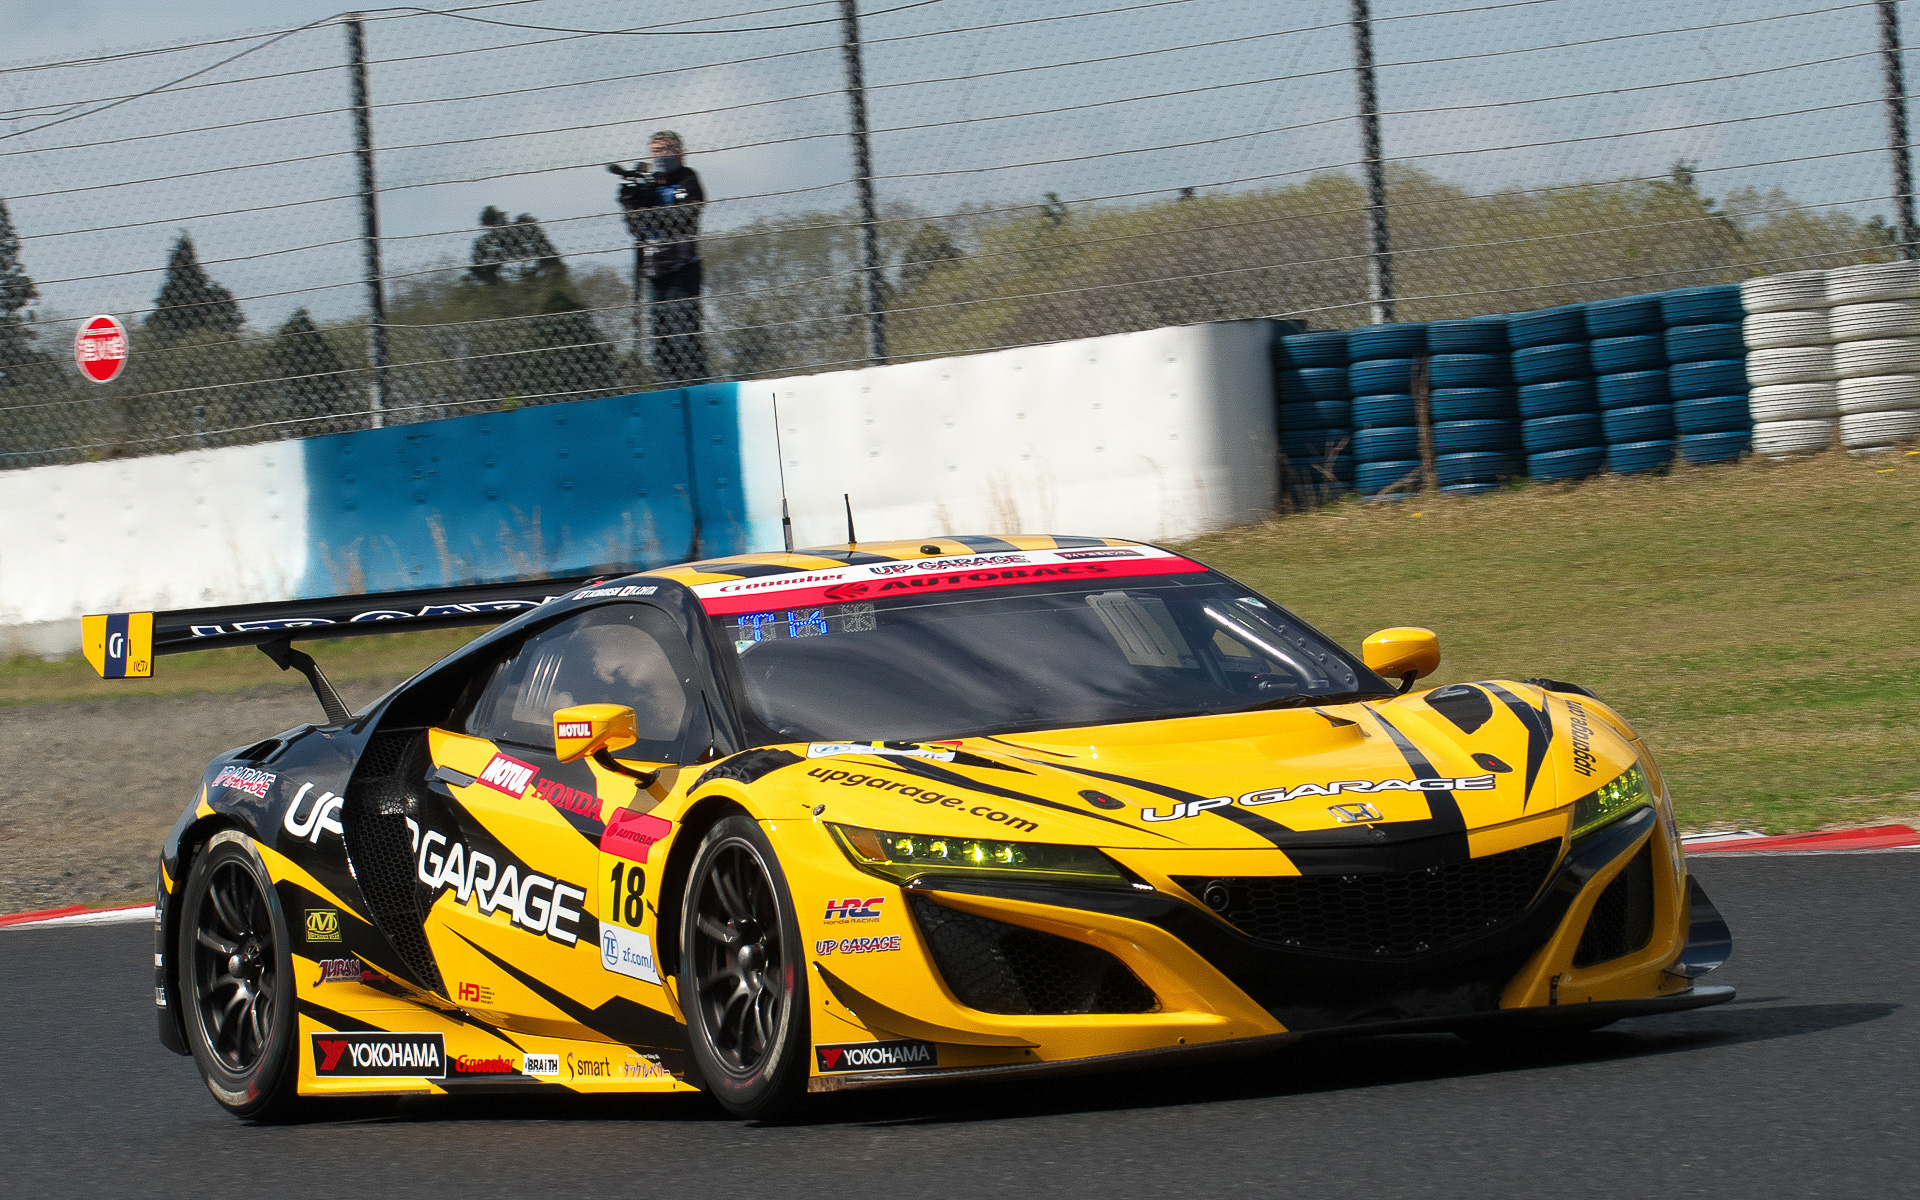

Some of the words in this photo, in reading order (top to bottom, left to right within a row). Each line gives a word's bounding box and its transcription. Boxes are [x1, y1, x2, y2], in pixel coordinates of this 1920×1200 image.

[869, 563, 913, 575] UP
[917, 555, 1032, 570] GARAGE
[879, 564, 1109, 592] AUTOBACS
[558, 723, 591, 737] MOTUL
[1565, 699, 1597, 777] upgarage.com
[480, 756, 533, 795] MOTUL
[531, 778, 604, 821] HONDA
[807, 766, 1039, 833] upgarage.com
[1140, 796, 1233, 823] UP
[1239, 774, 1496, 807] GARAGE
[418, 830, 586, 944] GARAGE
[610, 861, 646, 928] 18
[824, 897, 885, 920] HRC
[815, 939, 838, 955] UP
[839, 934, 901, 953] GARAGE
[313, 958, 360, 988] JURAN
[347, 1043, 440, 1067] YOKOHAMA
[577, 1057, 611, 1077] smart
[843, 1045, 931, 1066] YOKOHAMA
